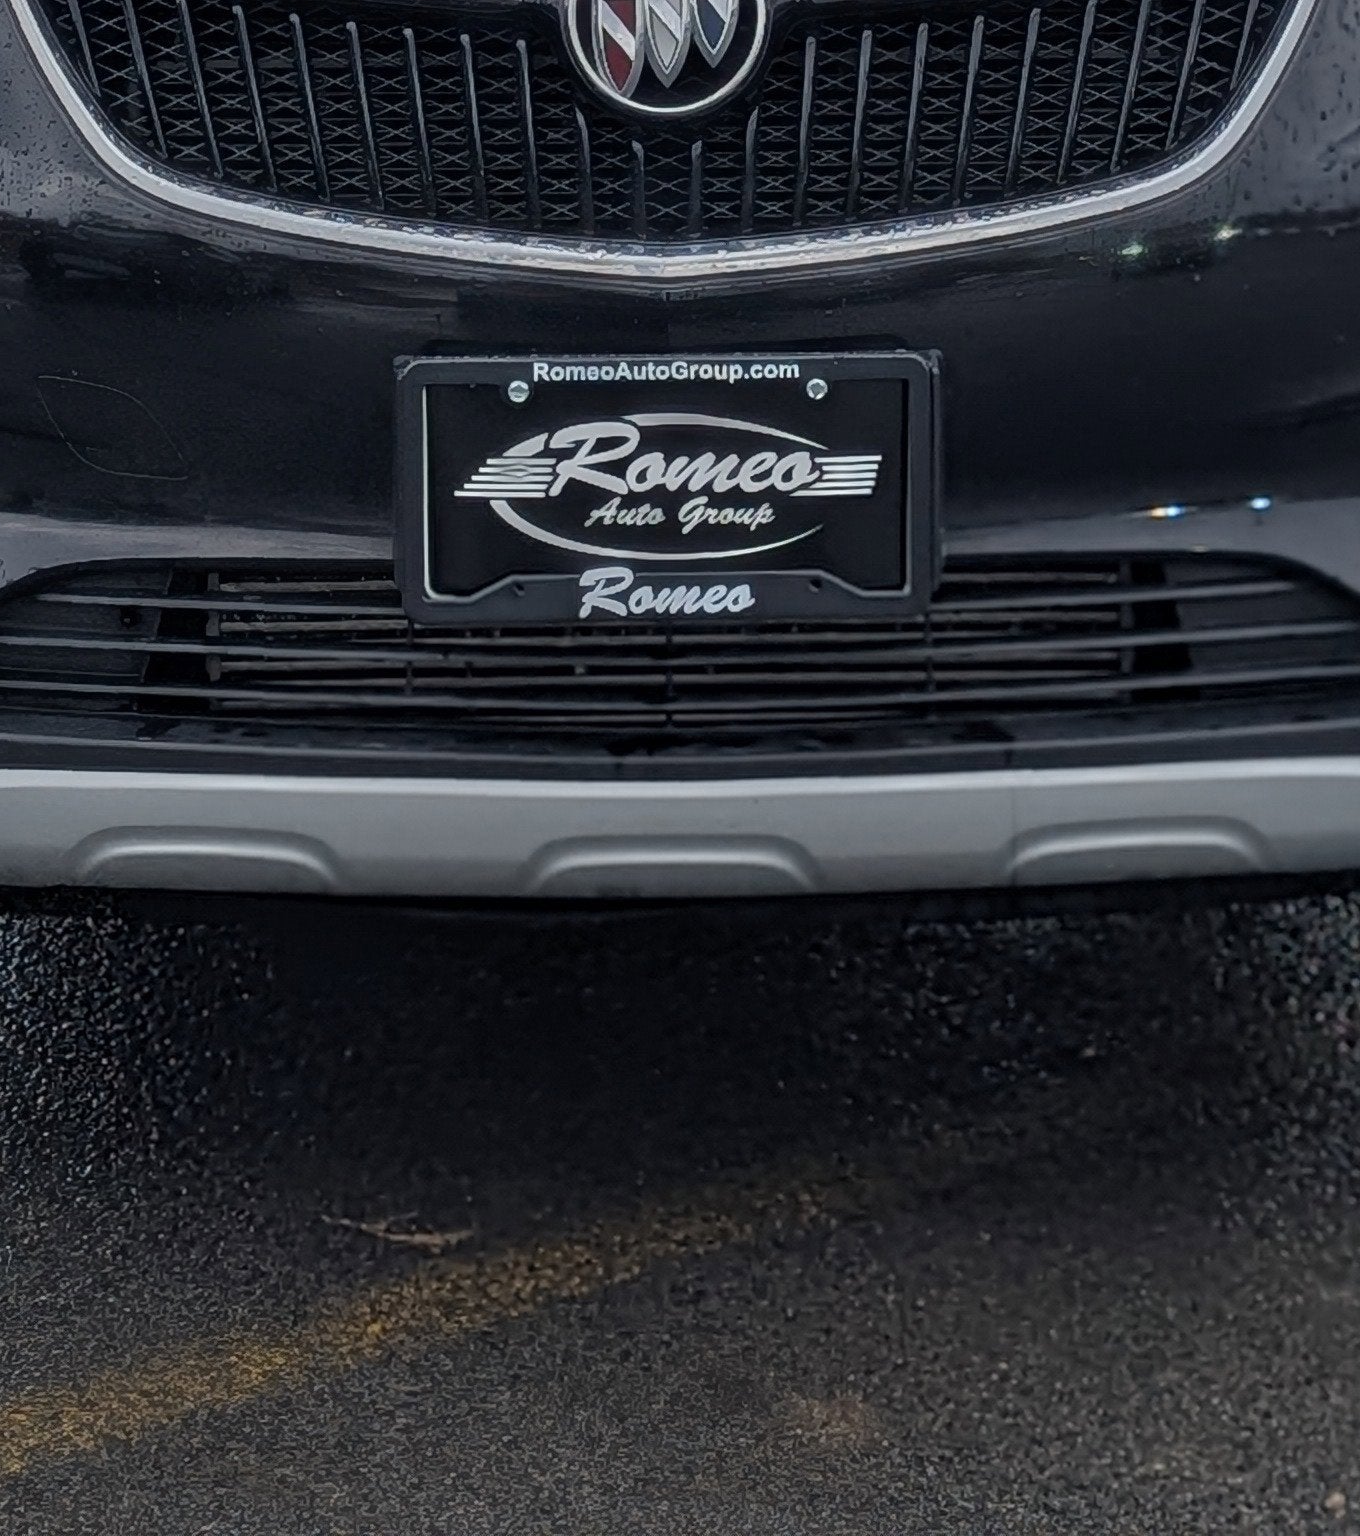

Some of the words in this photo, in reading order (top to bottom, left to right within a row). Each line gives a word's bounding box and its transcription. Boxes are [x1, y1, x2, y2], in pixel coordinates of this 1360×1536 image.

[532, 360, 800, 383] RomeoAutoGroup.com
[548, 421, 821, 497] Romeo
[584, 497, 666, 528] Auto
[678, 496, 776, 534] Group
[578, 567, 756, 619] Romeo
